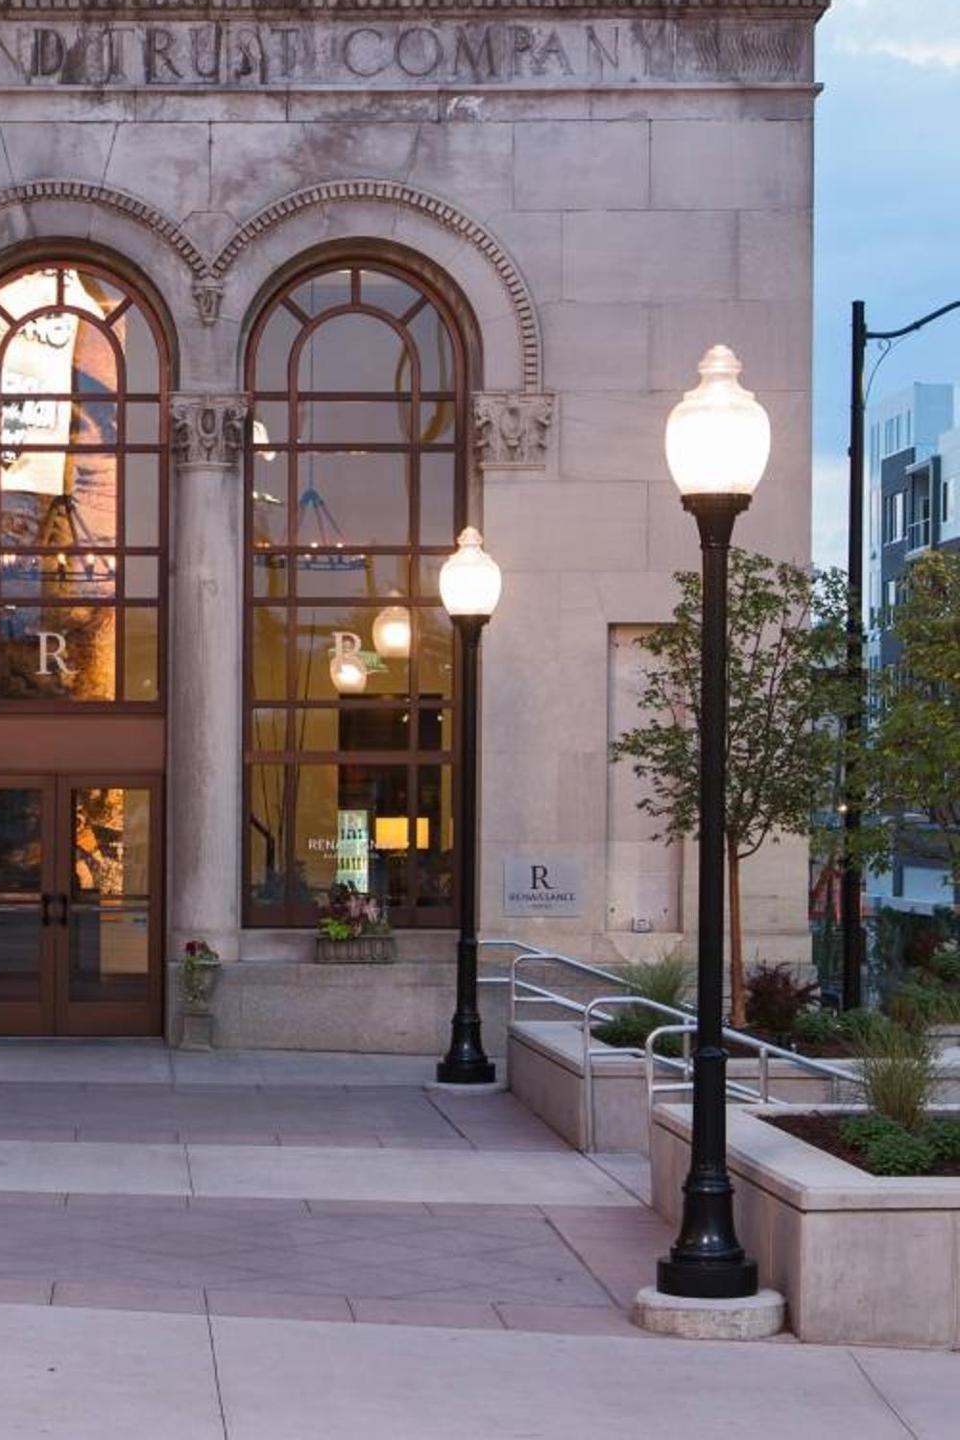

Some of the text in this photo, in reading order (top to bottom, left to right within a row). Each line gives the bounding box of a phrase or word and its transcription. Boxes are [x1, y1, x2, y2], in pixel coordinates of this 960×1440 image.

[98, 27, 301, 78] TRUST
[342, 26, 670, 78] COMPANY
[36, 631, 78, 674] R
[530, 864, 556, 890] R
